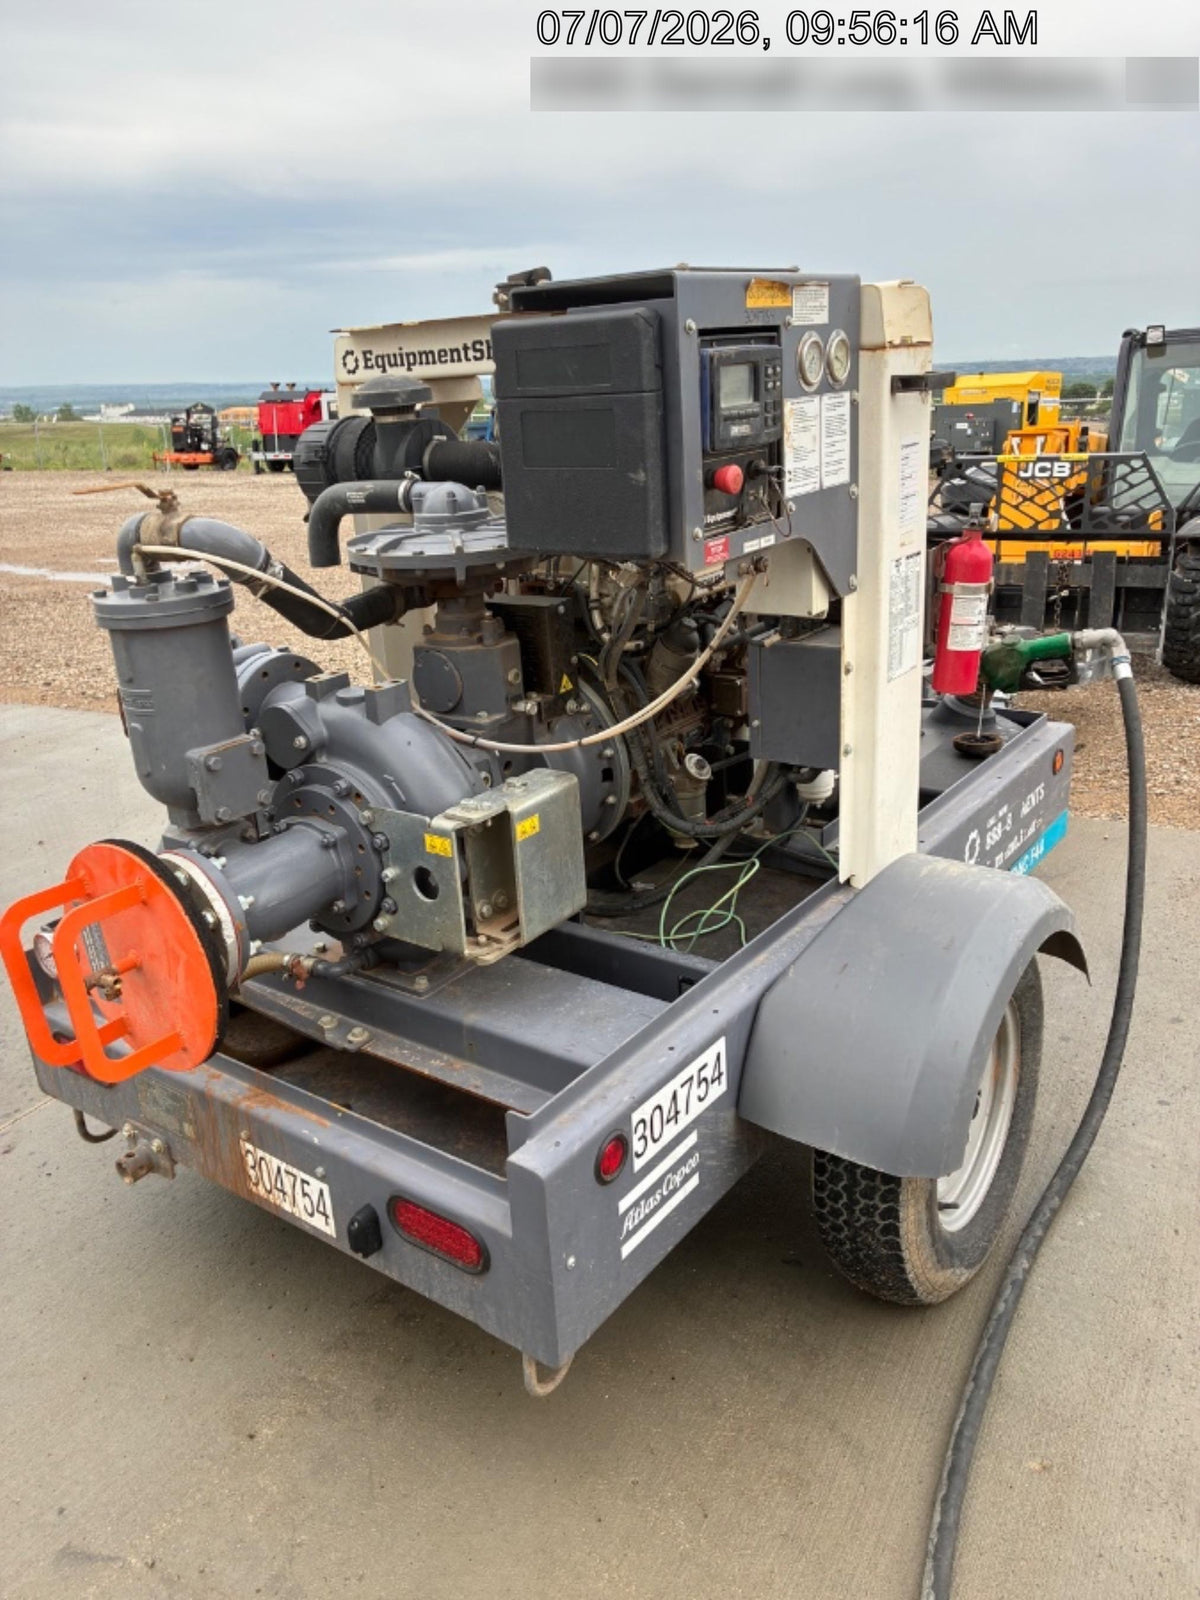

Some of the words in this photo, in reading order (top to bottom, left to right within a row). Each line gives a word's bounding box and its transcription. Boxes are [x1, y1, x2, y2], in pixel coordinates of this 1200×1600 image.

[1019, 462, 1071, 477] JCB
[633, 1051, 724, 1159] 304754
[244, 1148, 330, 1227] 304754
[620, 1190, 662, 1240] Atlas
[661, 1152, 699, 1197] Copco
